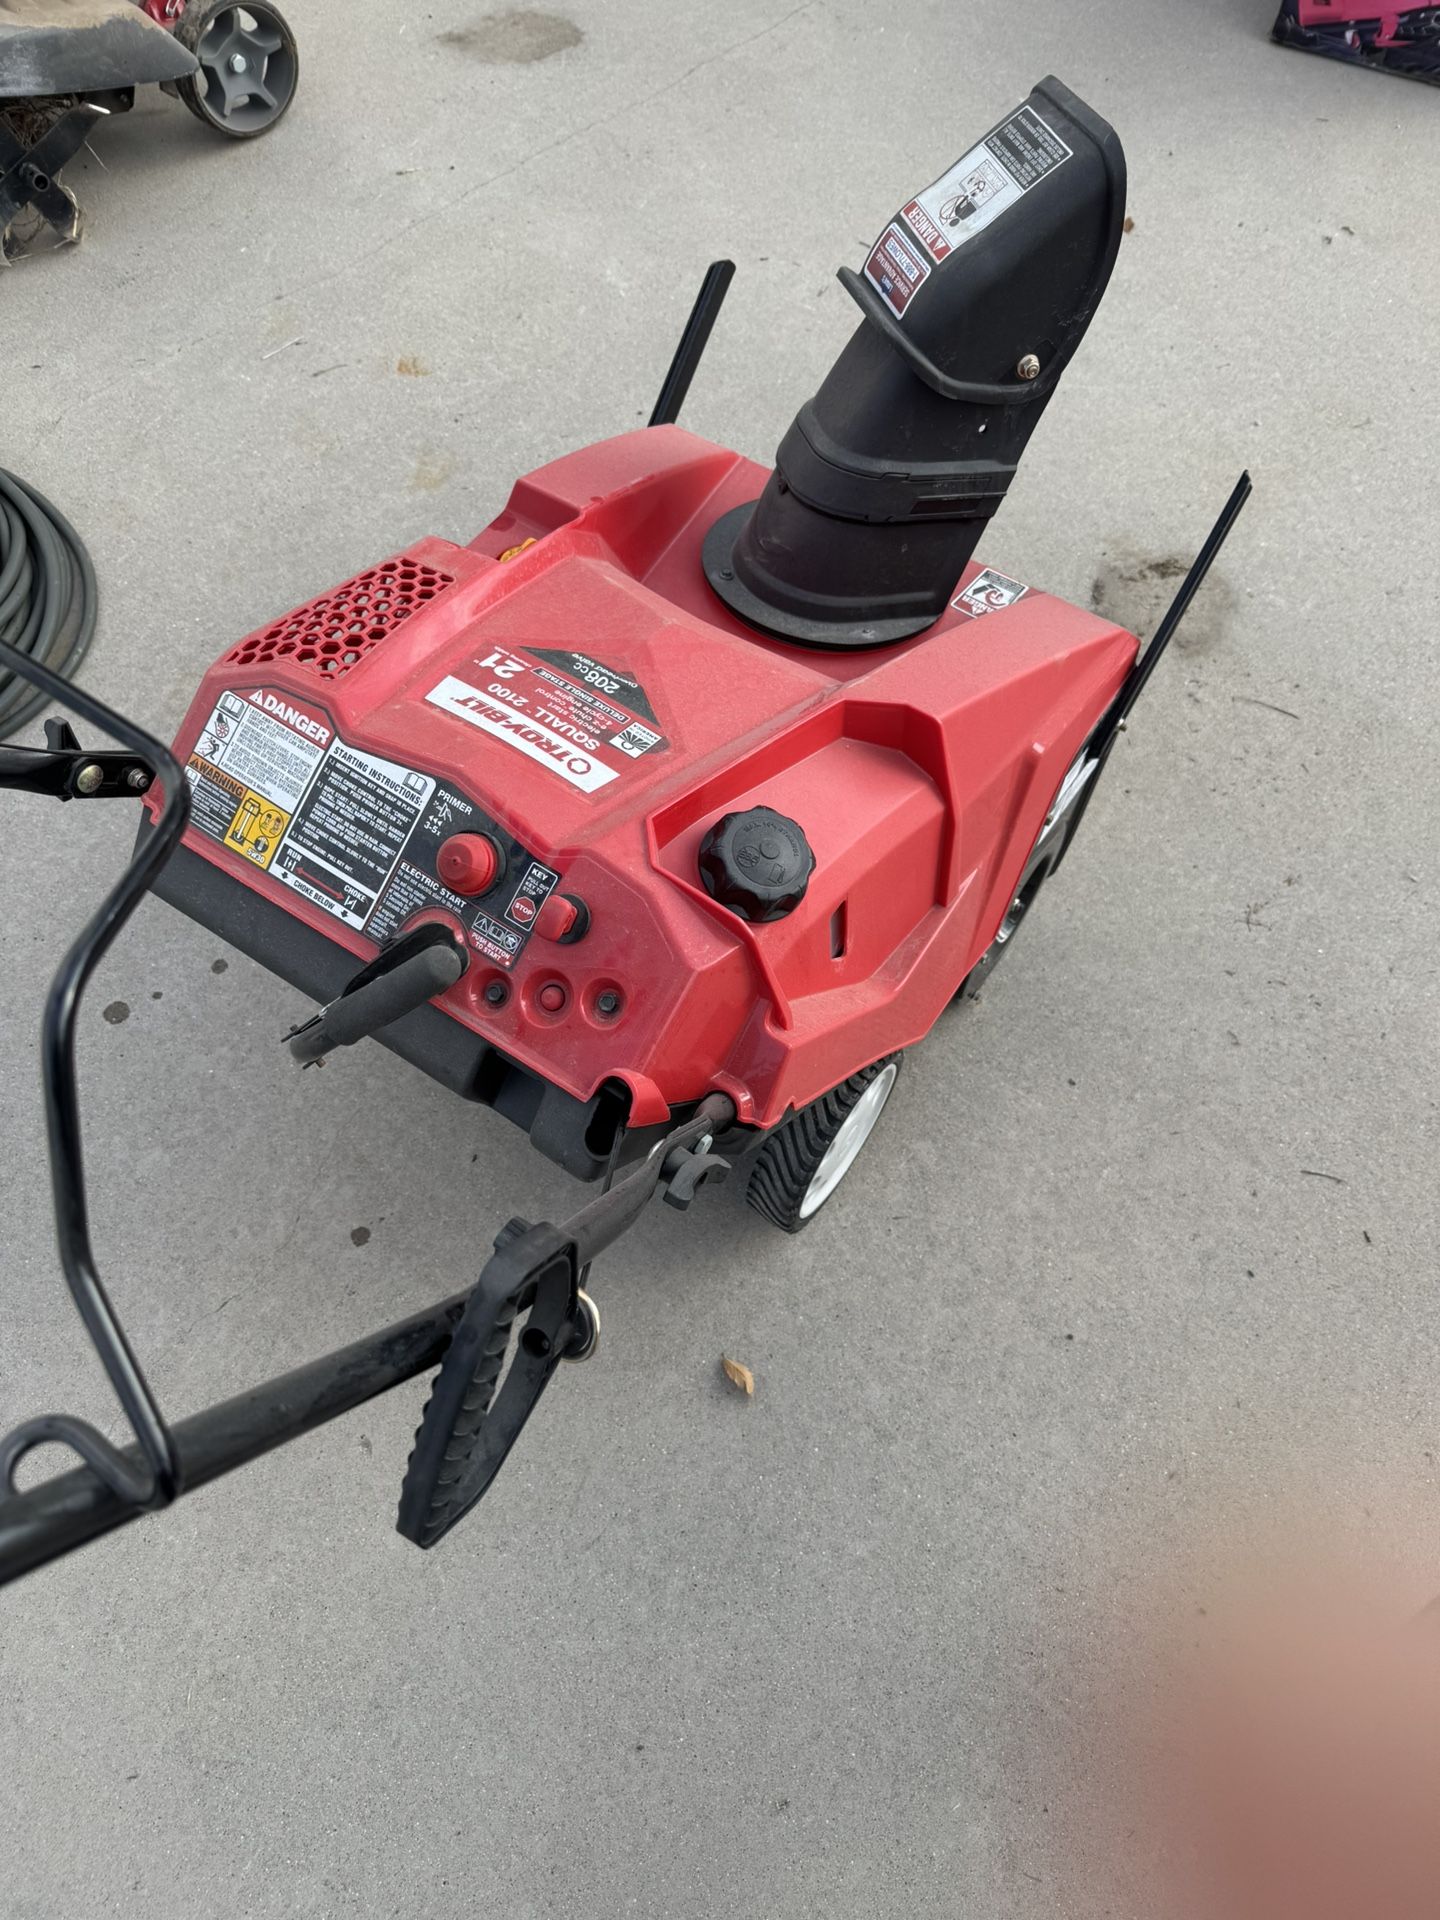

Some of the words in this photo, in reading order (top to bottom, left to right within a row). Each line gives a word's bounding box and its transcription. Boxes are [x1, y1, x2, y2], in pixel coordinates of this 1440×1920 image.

[906, 205, 939, 244] DANGER
[875, 250, 896, 280] ADVANTAGE
[893, 274, 910, 298] SERVICE
[538, 669, 565, 686] STAGE
[486, 682, 528, 708] 2100
[535, 687, 566, 706] control
[553, 689, 582, 707] engine
[564, 684, 593, 703] SINGLE
[546, 701, 568, 715] start
[581, 705, 614, 726] 4-cycle
[592, 700, 625, 721] DELUXE
[262, 693, 331, 745] DANGER
[453, 692, 573, 761] TROY-BILT
[568, 714, 600, 734] electric
[592, 719, 606, 729] e-z
[197, 761, 244, 796] WARNING
[332, 745, 369, 773] STARTING
[368, 767, 423, 807] INSTRUCTIONS:
[437, 789, 472, 815] PRIMER
[246, 847, 266, 864] 5W30
[286, 847, 302, 861] RUN
[527, 875, 539, 886] PULL
[538, 882, 549, 892] OUT
[531, 867, 548, 881] KEY
[293, 879, 313, 896] CHOKE
[312, 892, 335, 910] BELOW
[343, 884, 366, 902] CHOKE
[400, 861, 439, 891] ELECTRIC
[439, 887, 466, 909] START
[522, 885, 536, 897] STOP
[525, 880, 536, 890] KEY
[514, 901, 533, 917] STOP
[471, 931, 487, 945] PUSH
[486, 941, 510, 960] BUTTON
[474, 941, 484, 950] TO
[483, 946, 501, 961] START
